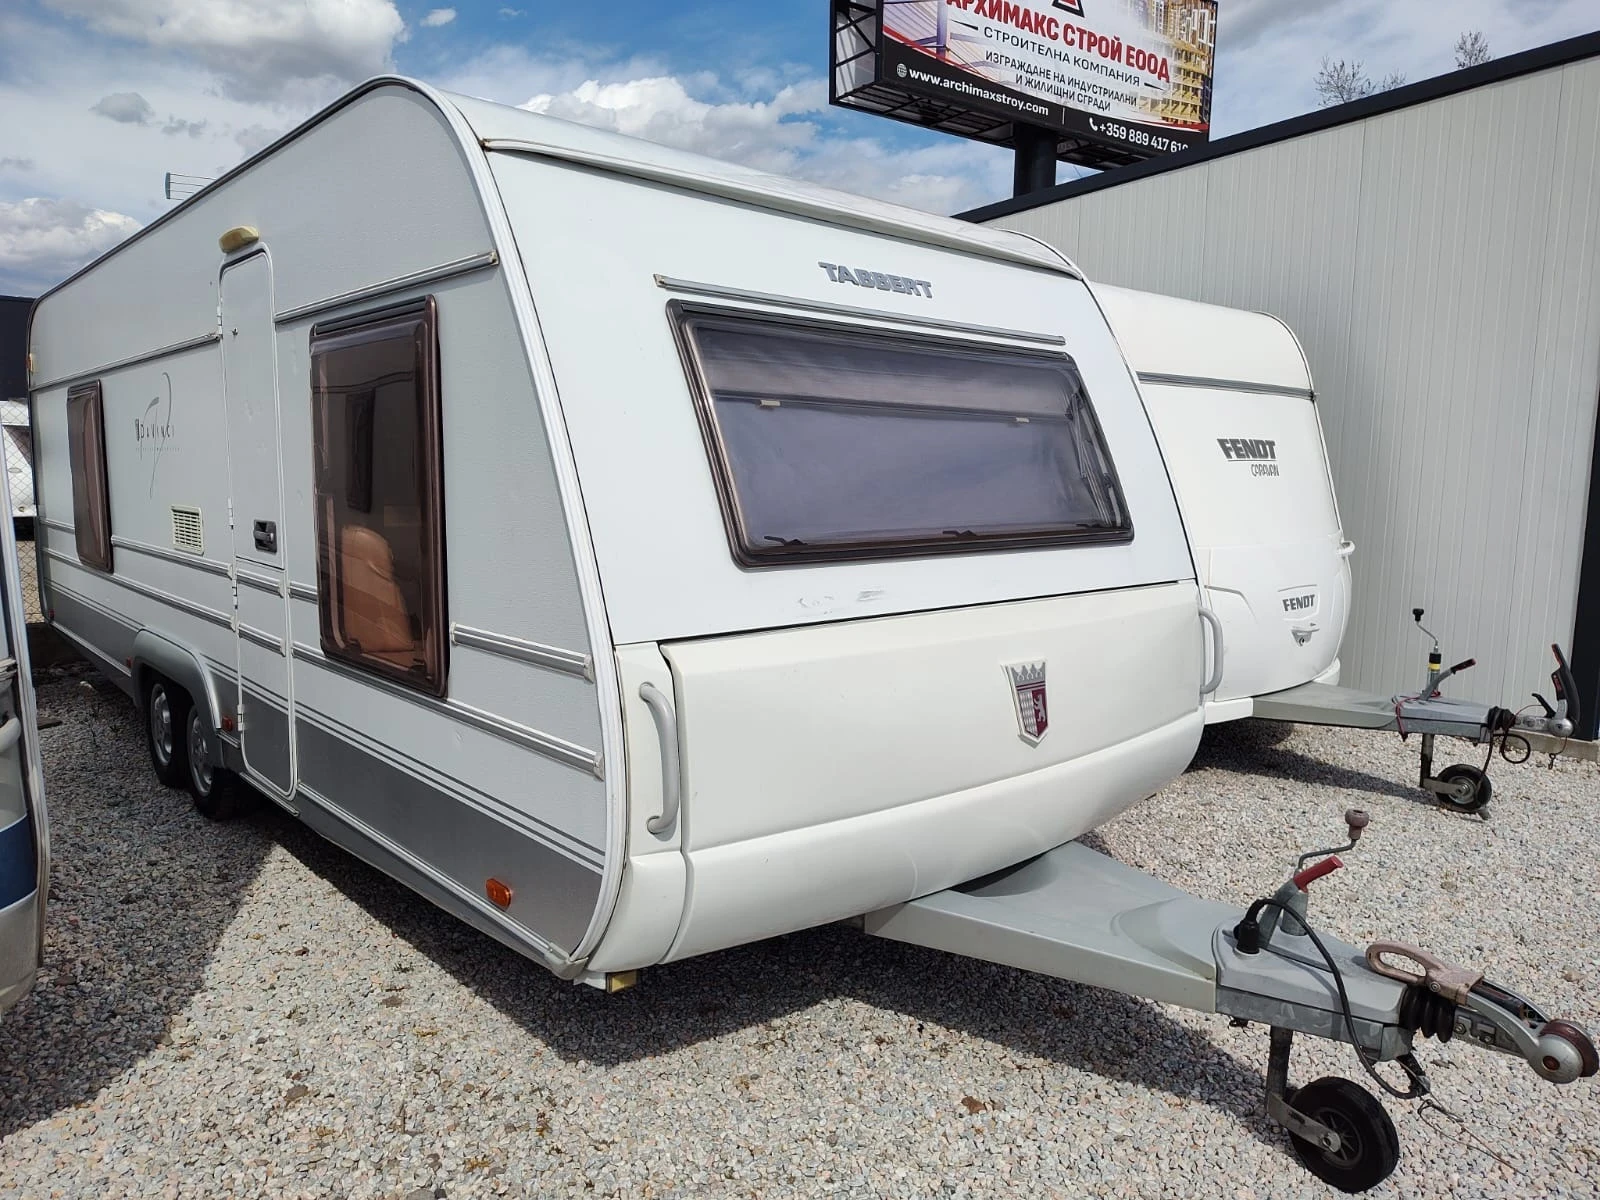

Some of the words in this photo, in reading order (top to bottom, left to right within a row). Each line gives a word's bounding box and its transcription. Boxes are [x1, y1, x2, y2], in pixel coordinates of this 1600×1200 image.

[984, 26, 1071, 64] СТРОИТЕЛНА
[1073, 55, 1141, 87] КОМПАНИЯ
[1063, 23, 1123, 63] СТРОЙ
[1126, 45, 1170, 83] ЕООД
[909, 68, 1050, 116] www.archimaxstroy.com
[985, 50, 1051, 80] ИЗГРАЖДАНЕ
[1053, 72, 1066, 84] НА
[1067, 76, 1138, 106] ИНДУСТРИАЛНИ
[1015, 73, 1023, 84] И
[1025, 76, 1076, 100] ЖИЛИЩНИ
[1077, 92, 1111, 112] СГРАДИ
[1099, 122, 1127, 140] +359
[1128, 129, 1149, 146] 889
[1151, 136, 1169, 151] 417
[817, 261, 933, 299] TABBERT
[1216, 438, 1276, 459] FENDT
[1282, 594, 1315, 612] FENDT
